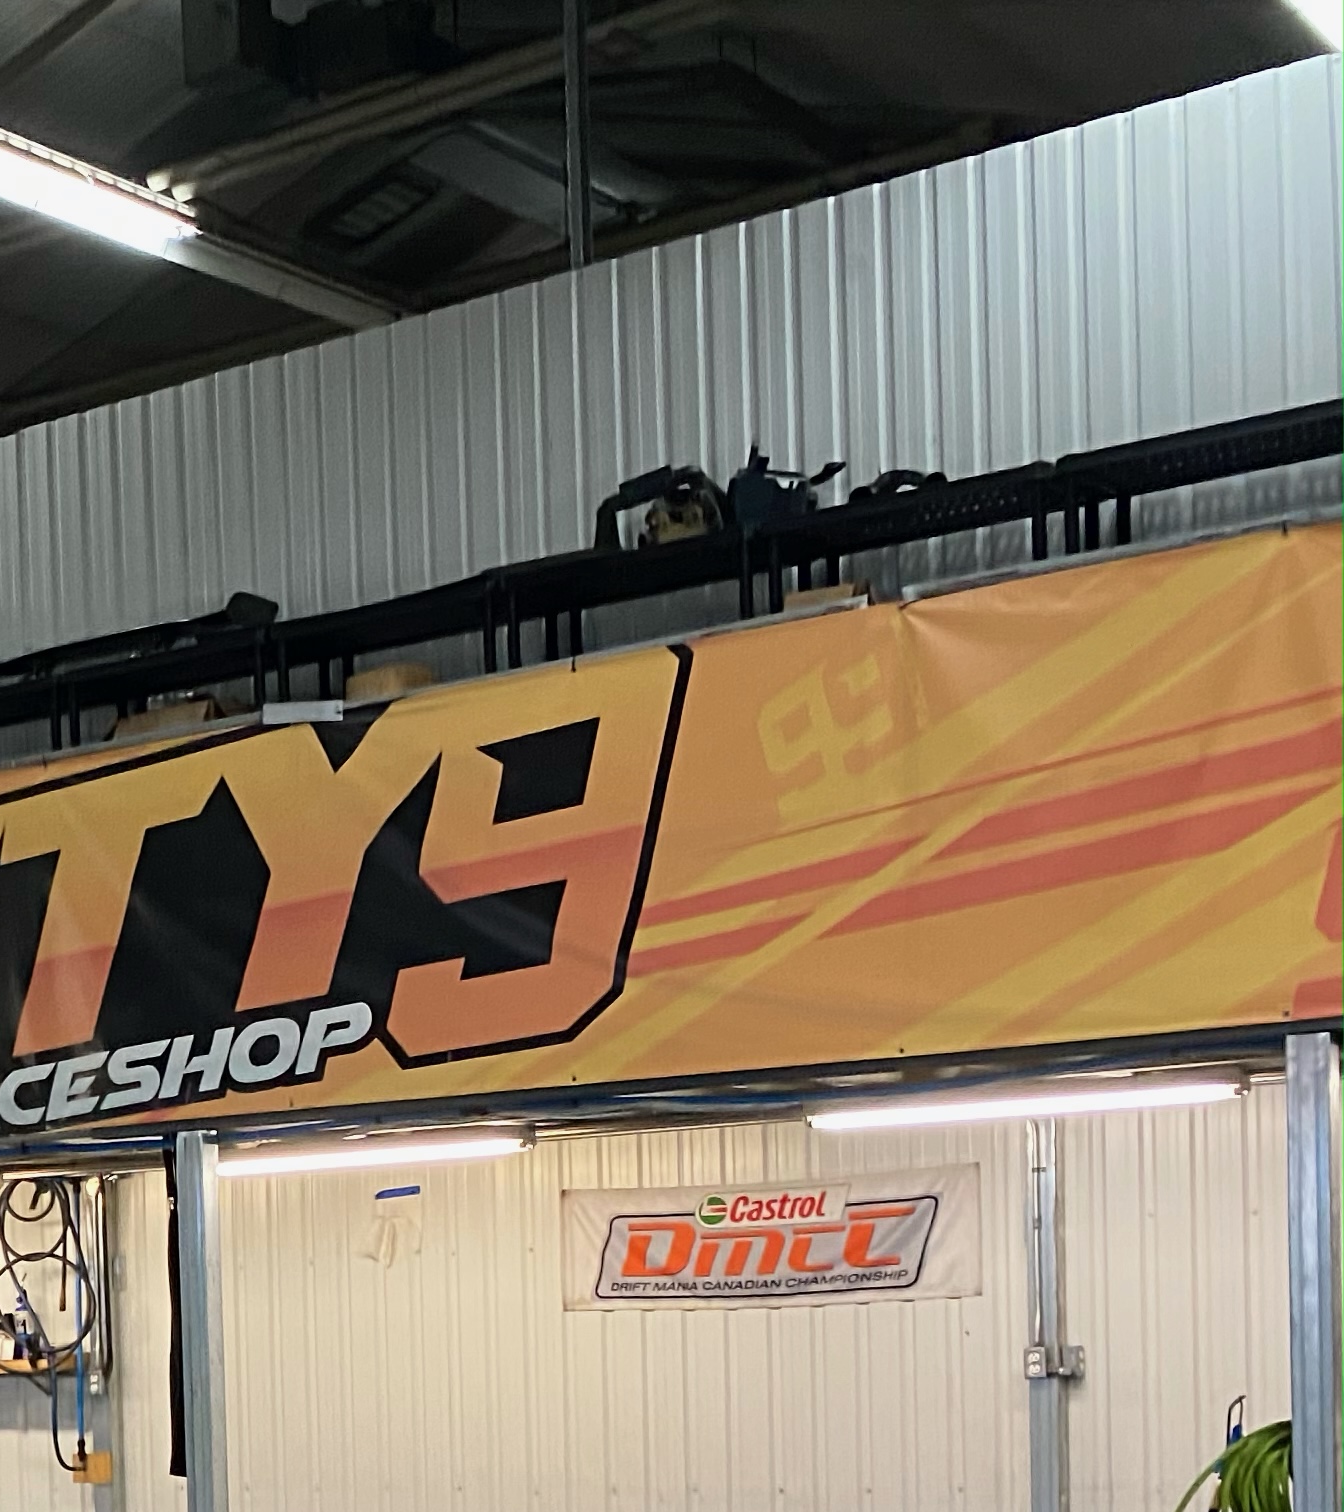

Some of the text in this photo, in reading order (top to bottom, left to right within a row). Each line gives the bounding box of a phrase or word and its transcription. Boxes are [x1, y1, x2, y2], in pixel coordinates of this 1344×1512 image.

[730, 1190, 827, 1224] Castrol
[610, 1268, 909, 1292] DRIFT MANIA CANADIAN CHAMPIONSHIP
